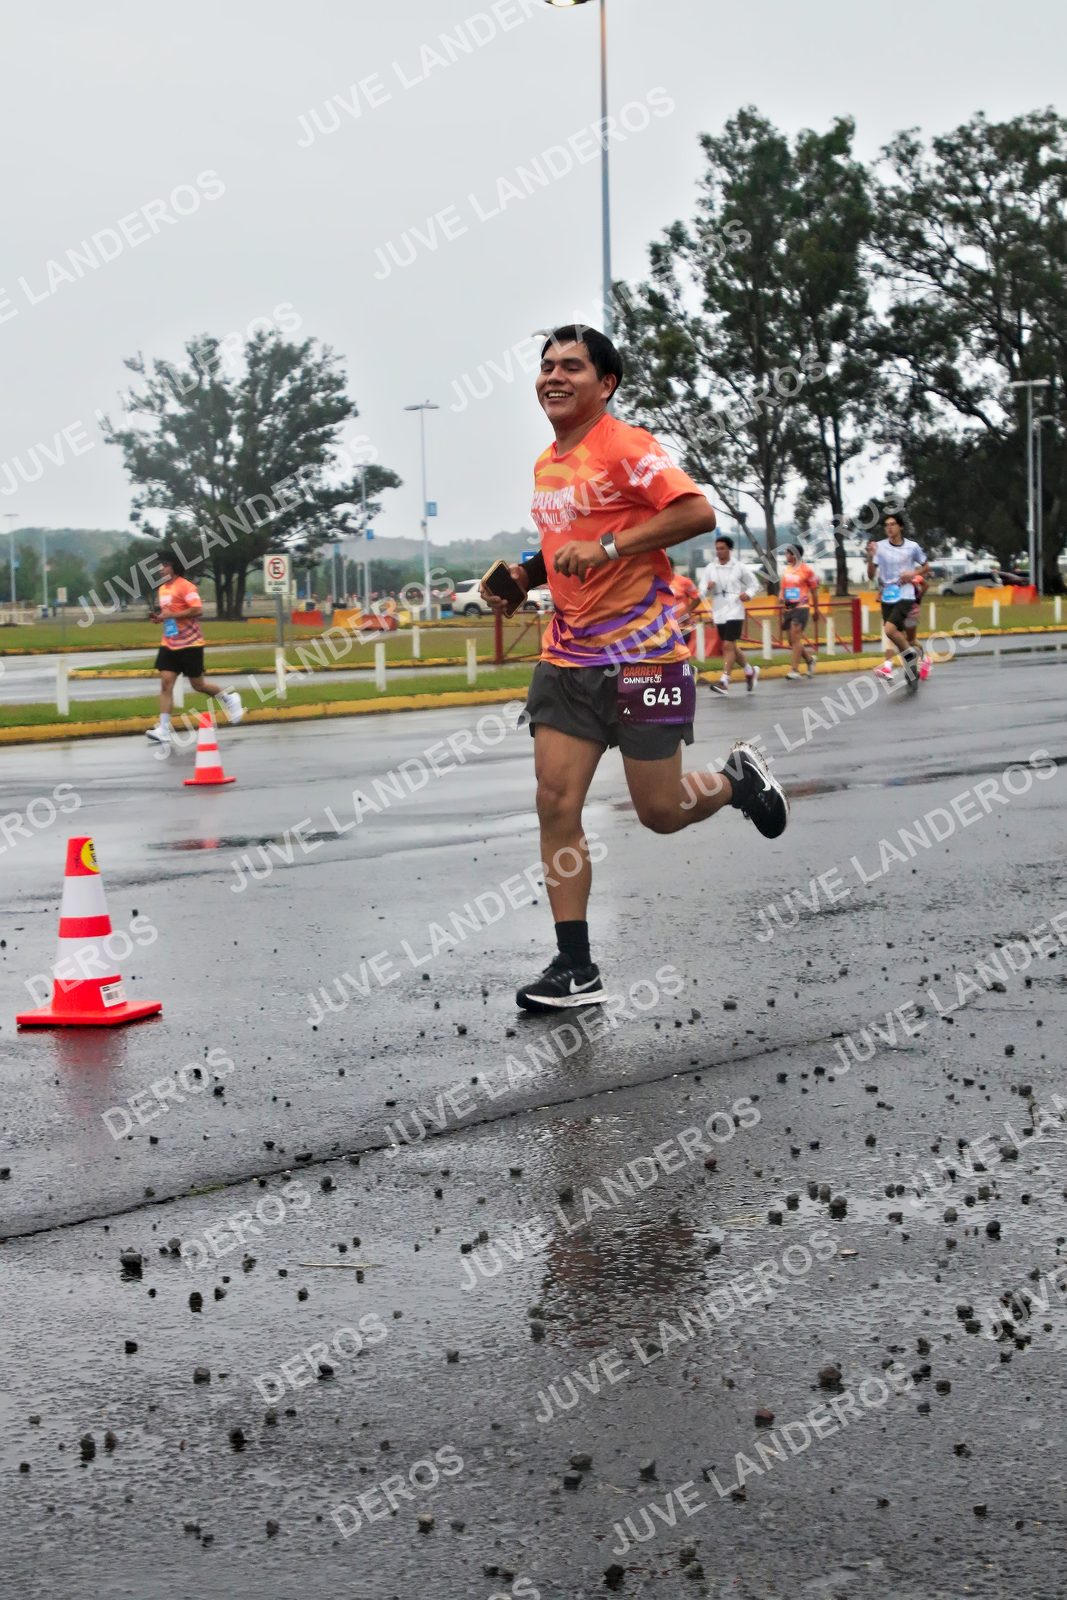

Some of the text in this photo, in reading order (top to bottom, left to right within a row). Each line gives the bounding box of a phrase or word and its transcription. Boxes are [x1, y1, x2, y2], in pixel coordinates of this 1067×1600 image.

[623, 665, 662, 677] CARRERA
[623, 676, 653, 684] OMNILIFE
[643, 686, 682, 706] 643
